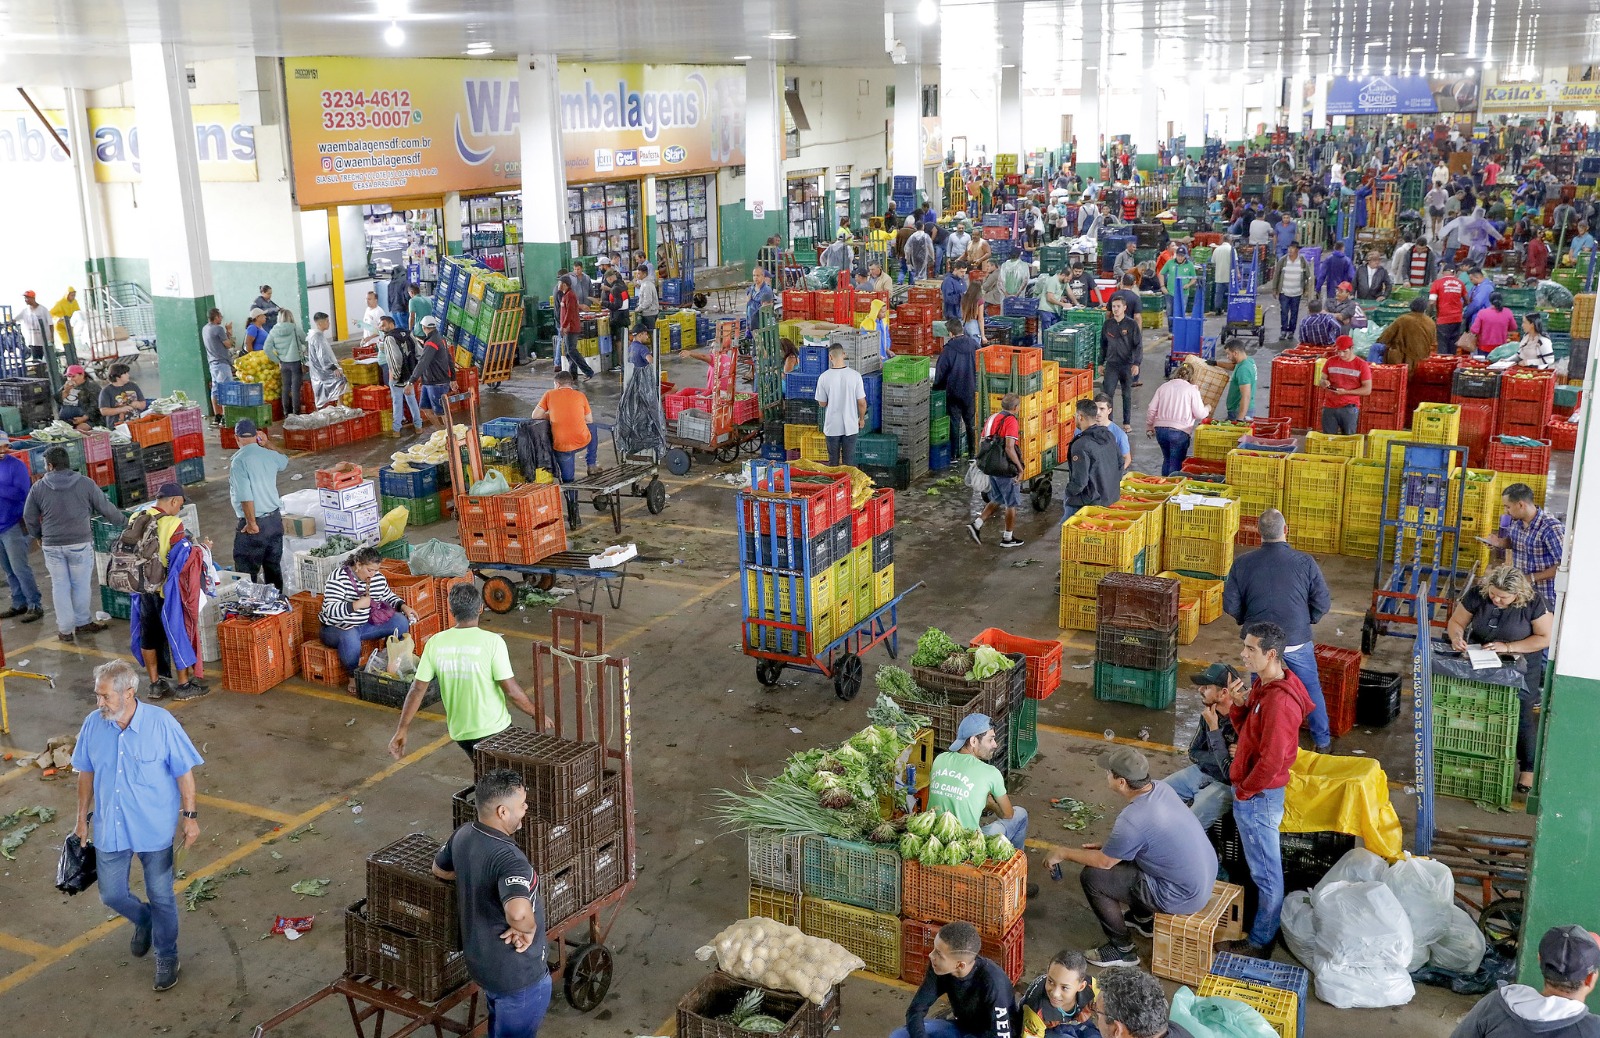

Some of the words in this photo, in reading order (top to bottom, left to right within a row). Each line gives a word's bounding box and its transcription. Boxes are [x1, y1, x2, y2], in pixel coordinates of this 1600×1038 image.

[322, 91, 411, 109] 3234-4612
[1358, 92, 1397, 104] Queijos
[1485, 87, 1544, 101] Keila's
[560, 81, 698, 138] mbalagens
[323, 110, 411, 129] 3233-0007
[318, 137, 432, 154] waembalagensdf.com.br
[665, 147, 684, 161] Start
[334, 153, 422, 172] @waembalagensdf
[1413, 654, 1423, 708] GALEGO
[1414, 712, 1423, 729] DA
[1414, 733, 1424, 793] CENOURA
[940, 783, 970, 798] CAMILO
